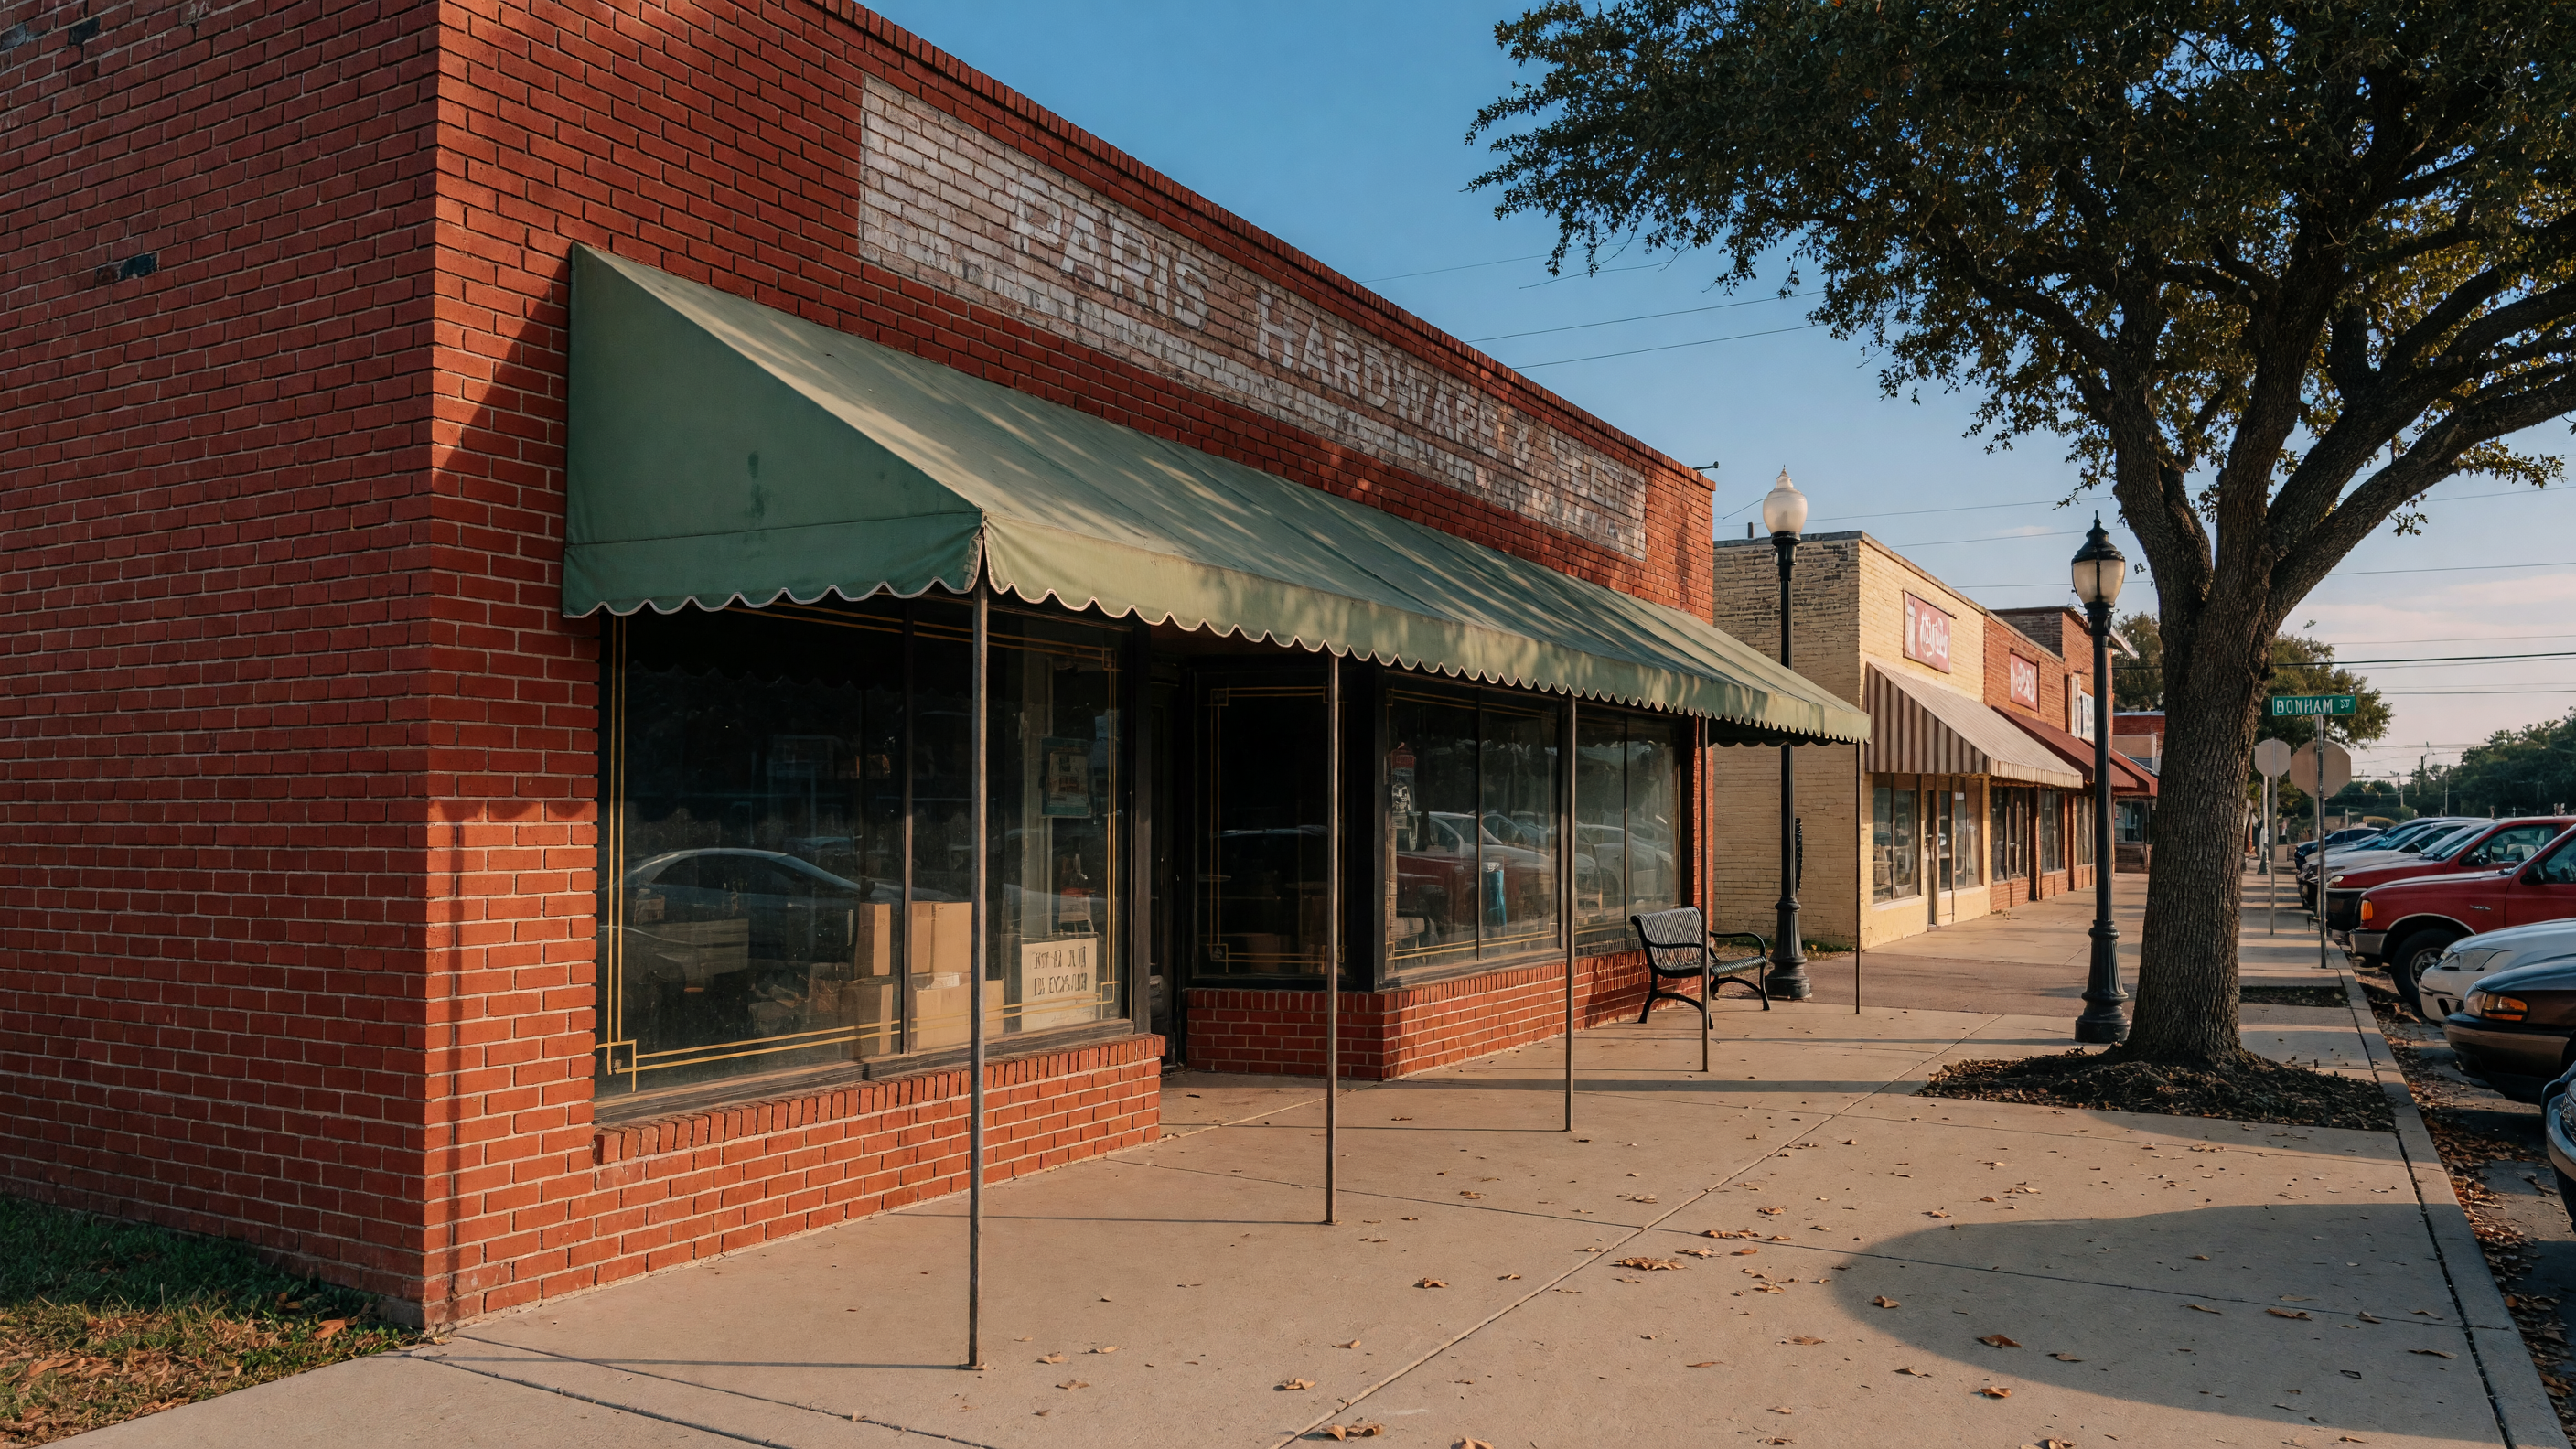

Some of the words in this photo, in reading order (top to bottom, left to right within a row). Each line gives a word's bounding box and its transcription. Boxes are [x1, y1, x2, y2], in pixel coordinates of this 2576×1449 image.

[1014, 188, 1209, 330] PARIS
[1256, 292, 1499, 459] HARDWARE
[2276, 698, 2333, 714] BONHAM
